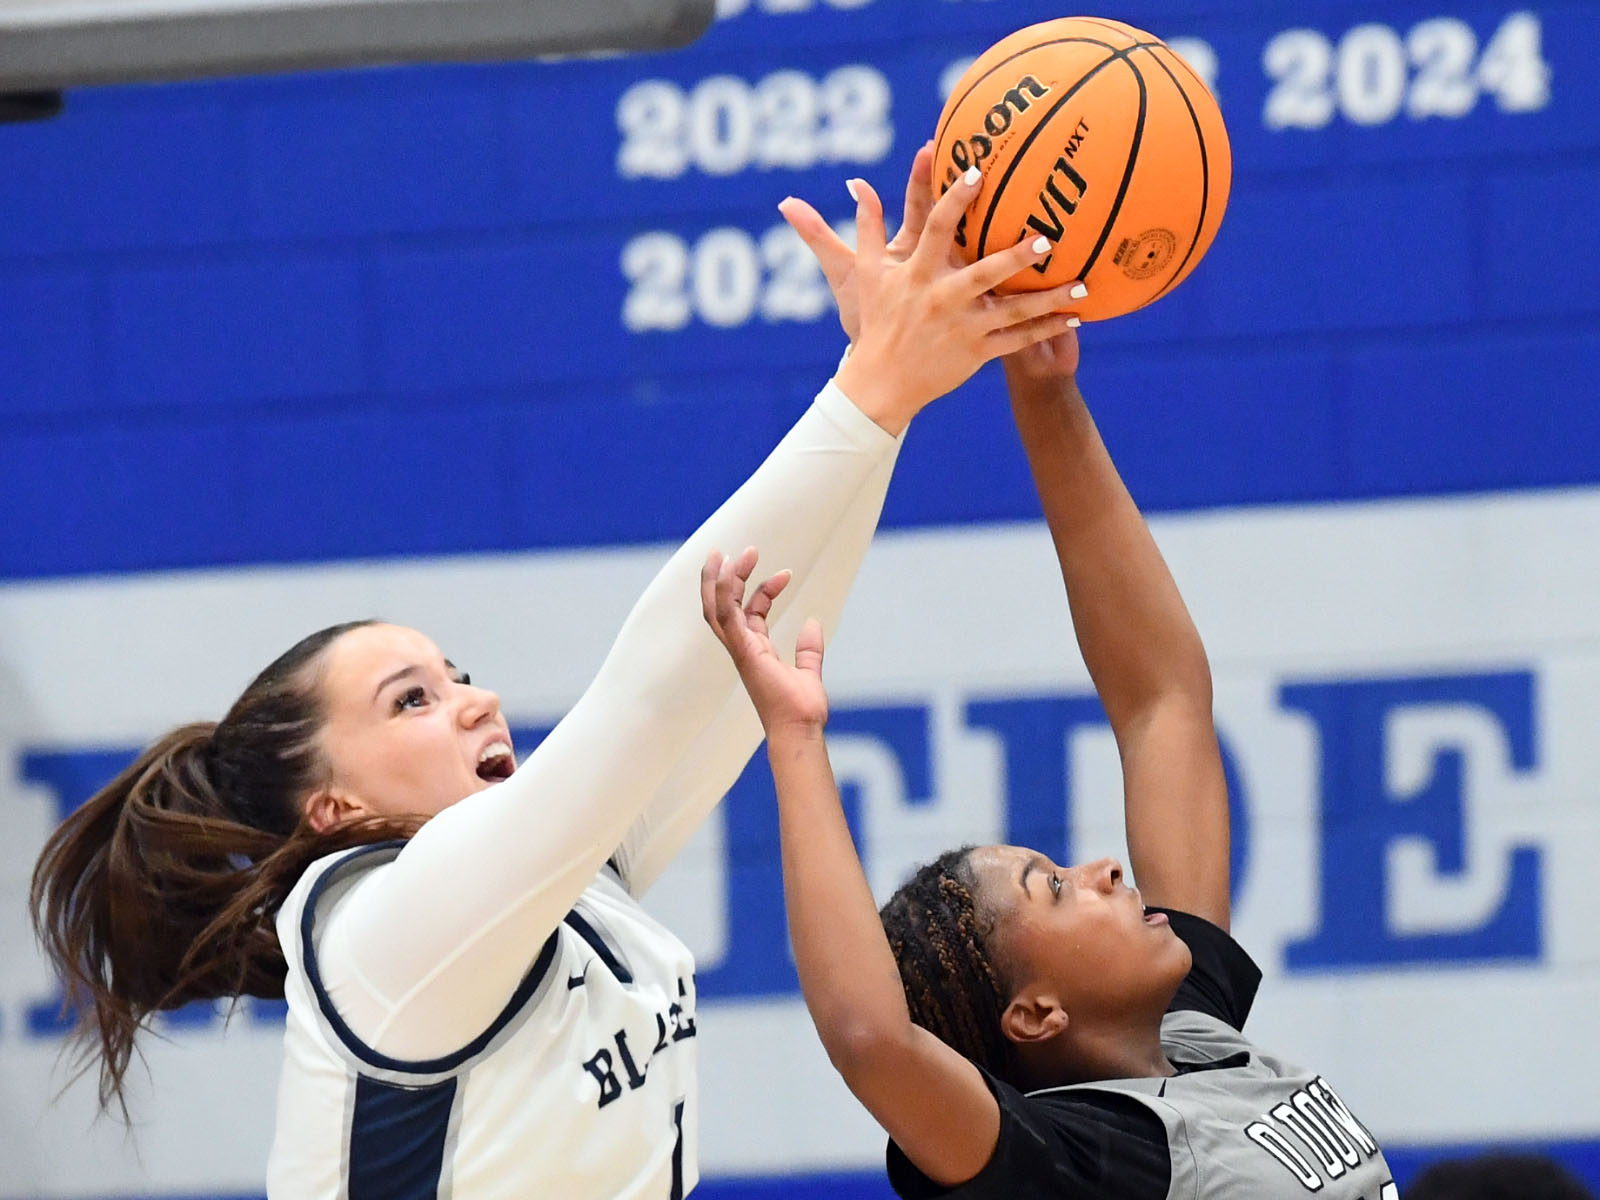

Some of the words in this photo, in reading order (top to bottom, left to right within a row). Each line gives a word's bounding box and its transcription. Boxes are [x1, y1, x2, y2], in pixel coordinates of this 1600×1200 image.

[616, 64, 893, 180] 2022
[1262, 11, 1552, 131] 2024
[940, 74, 1051, 248] lson
[1063, 117, 1091, 159] NXT
[620, 217, 892, 333] 202
